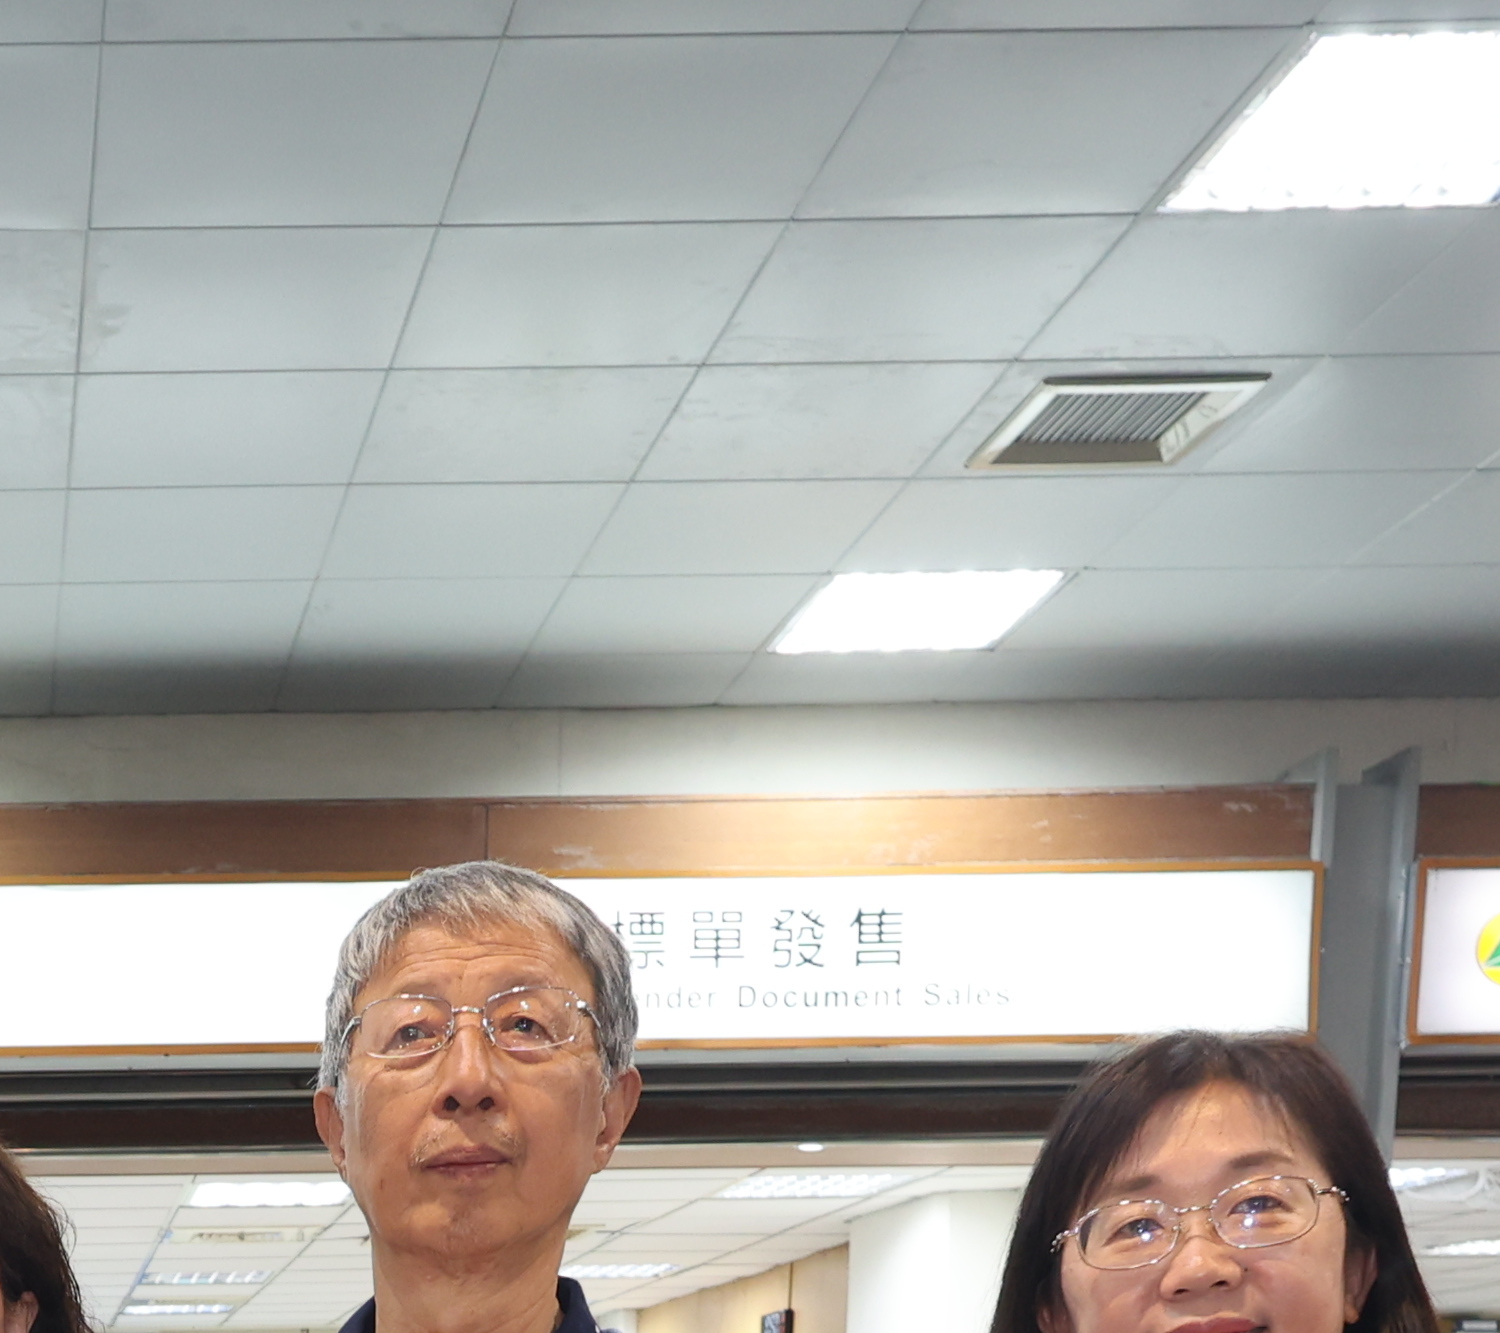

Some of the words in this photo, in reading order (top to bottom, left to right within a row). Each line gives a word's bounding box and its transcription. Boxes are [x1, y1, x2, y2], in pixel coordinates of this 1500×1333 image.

[609, 908, 904, 969] 標單發售
[738, 985, 903, 1008] Document
[923, 982, 1011, 1007] Sales
